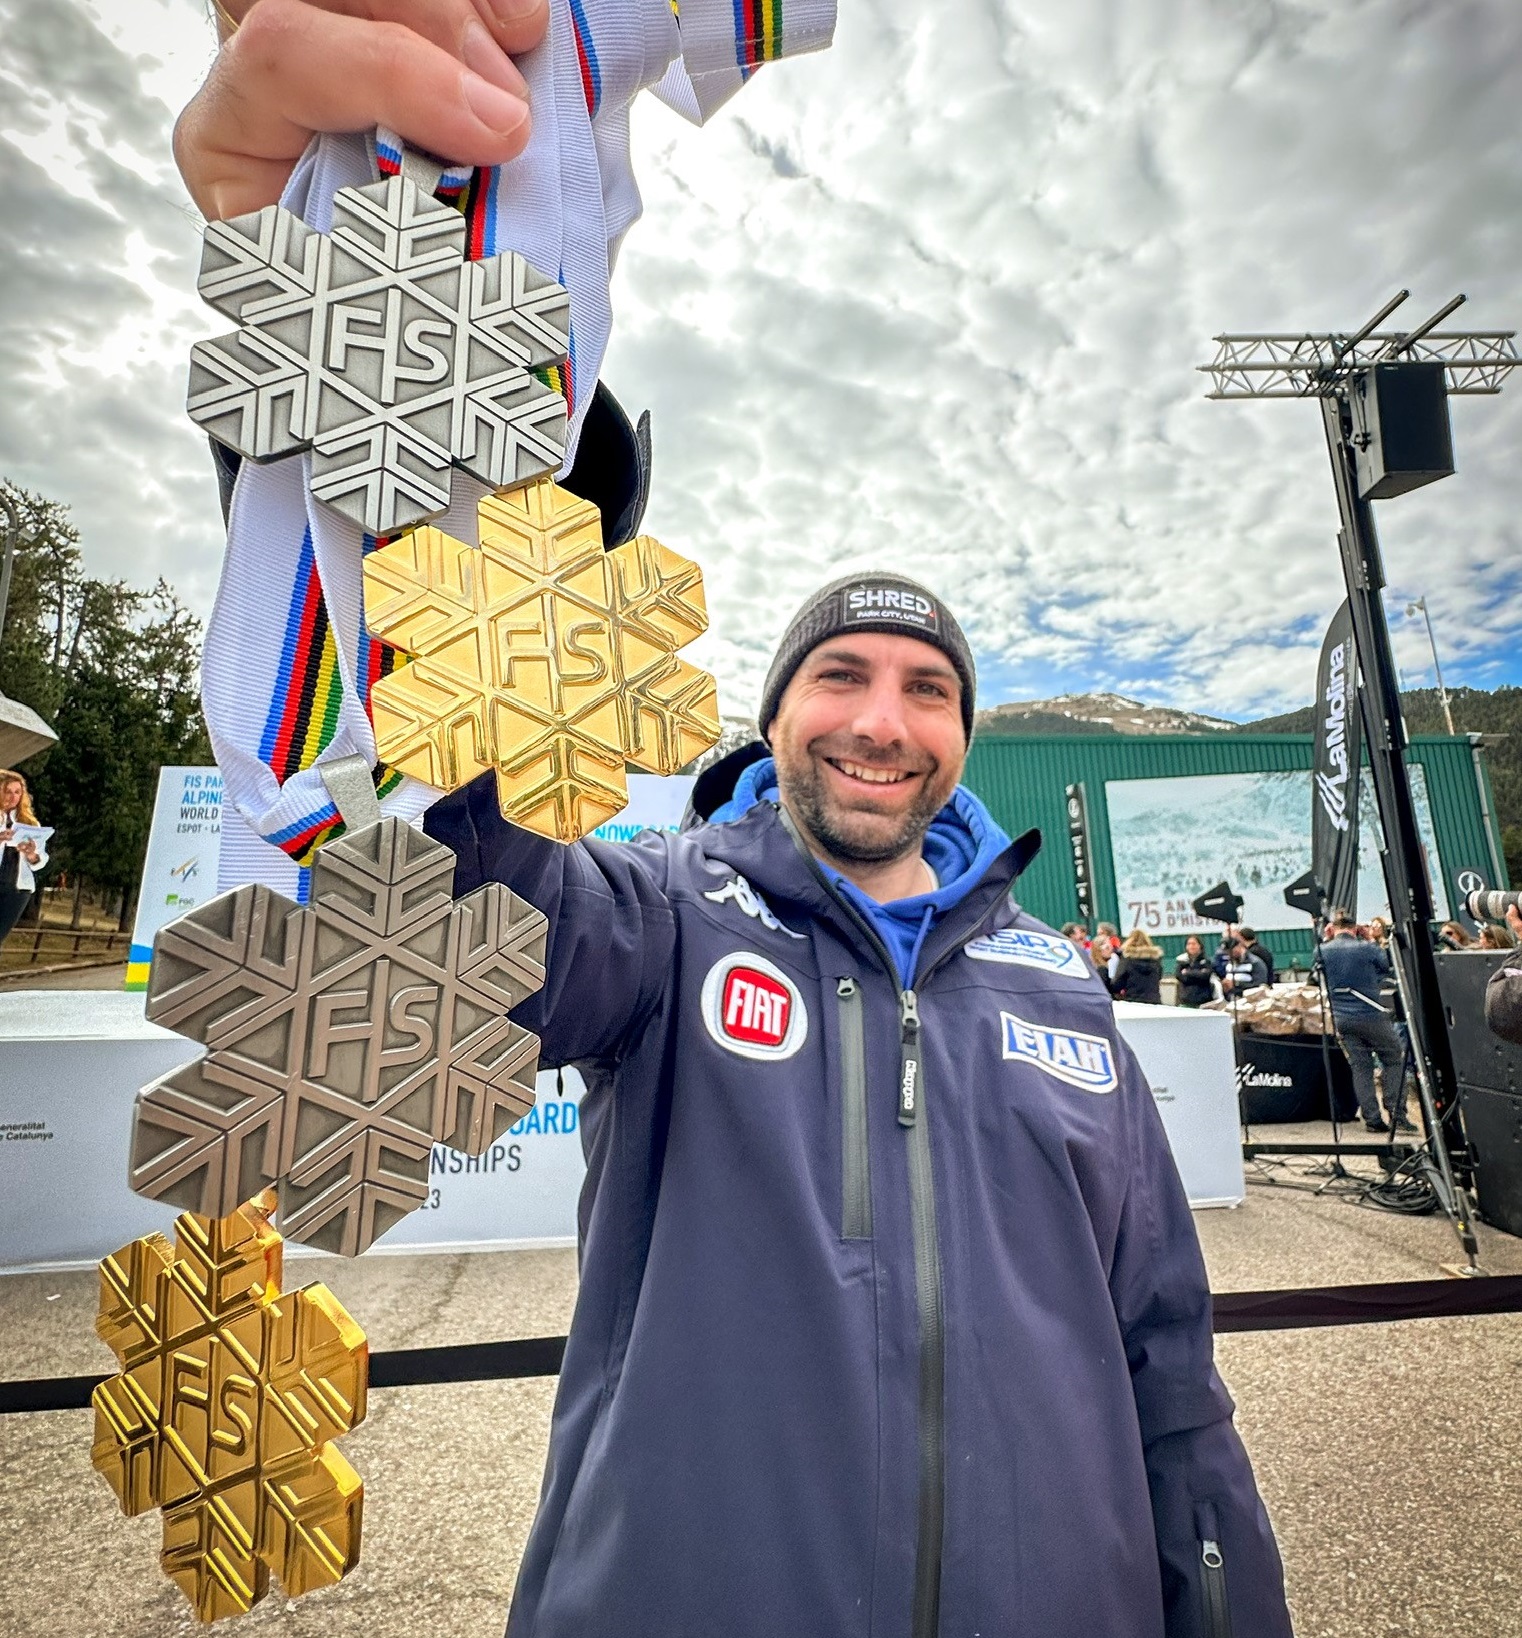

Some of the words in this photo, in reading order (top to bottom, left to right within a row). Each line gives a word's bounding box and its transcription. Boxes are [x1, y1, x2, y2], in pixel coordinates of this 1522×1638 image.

[327, 288, 455, 405] FIS
[857, 610, 879, 618] PARK
[904, 613, 926, 624] UTAH
[501, 592, 608, 715] FIS
[1325, 642, 1348, 785] LaMolina
[184, 775, 201, 788] FIS
[177, 824, 202, 834] ESPOT
[180, 806, 219, 820] WORLD
[1127, 900, 1161, 929] 75
[307, 959, 440, 1102] FIS
[726, 978, 787, 1037] FIAT
[903, 1060, 917, 1110] Kappa
[1245, 1072, 1292, 1087] LaMolina
[172, 1335, 258, 1486] FIS
